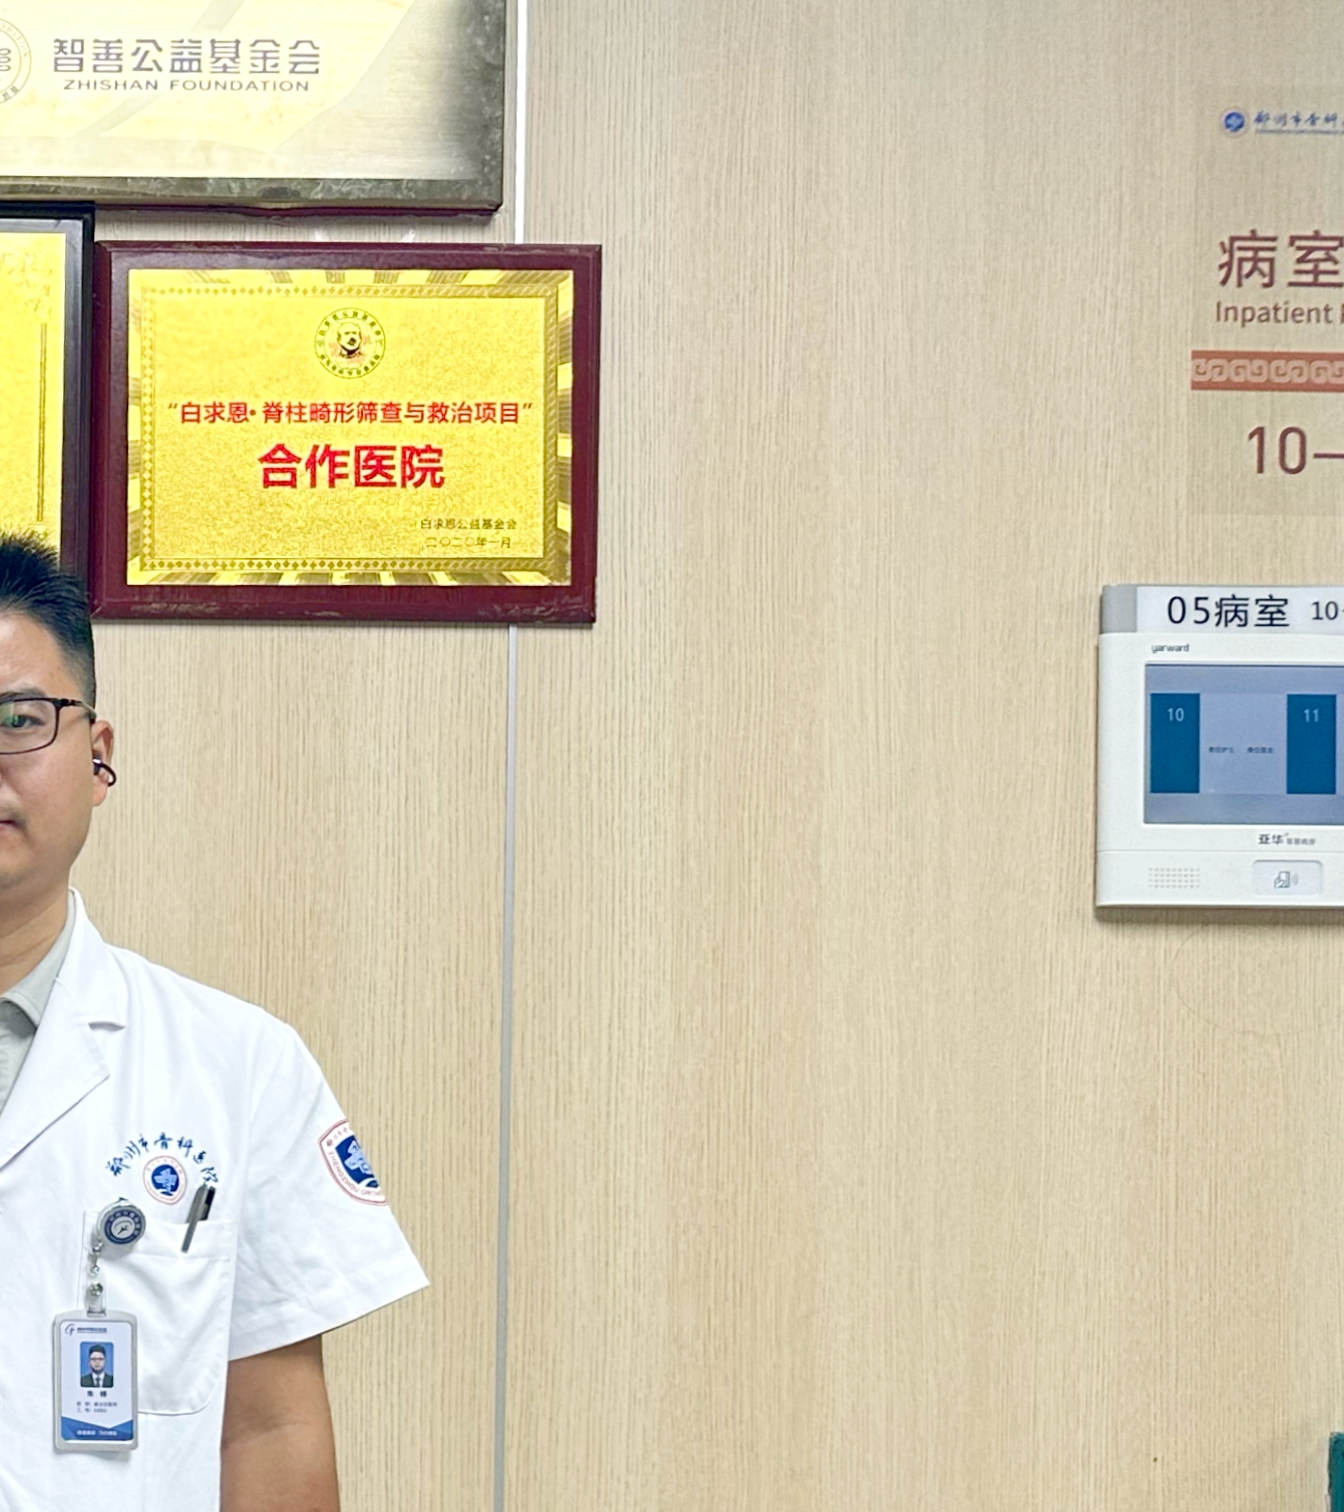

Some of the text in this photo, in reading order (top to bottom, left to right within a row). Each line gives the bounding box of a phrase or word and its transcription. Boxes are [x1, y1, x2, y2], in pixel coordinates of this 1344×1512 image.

[53, 38, 320, 74] 智善公益基金会
[63, 79, 310, 92] ZHISHAN FOUNDATION
[1218, 229, 1344, 288] 病室
[1216, 301, 1333, 328] Inpatient
[257, 443, 446, 489] 合作医院
[1167, 594, 1290, 628] 05病室
[1151, 643, 1190, 654] yarward
[1166, 707, 1185, 722] 10
[1303, 708, 1319, 723] 11
